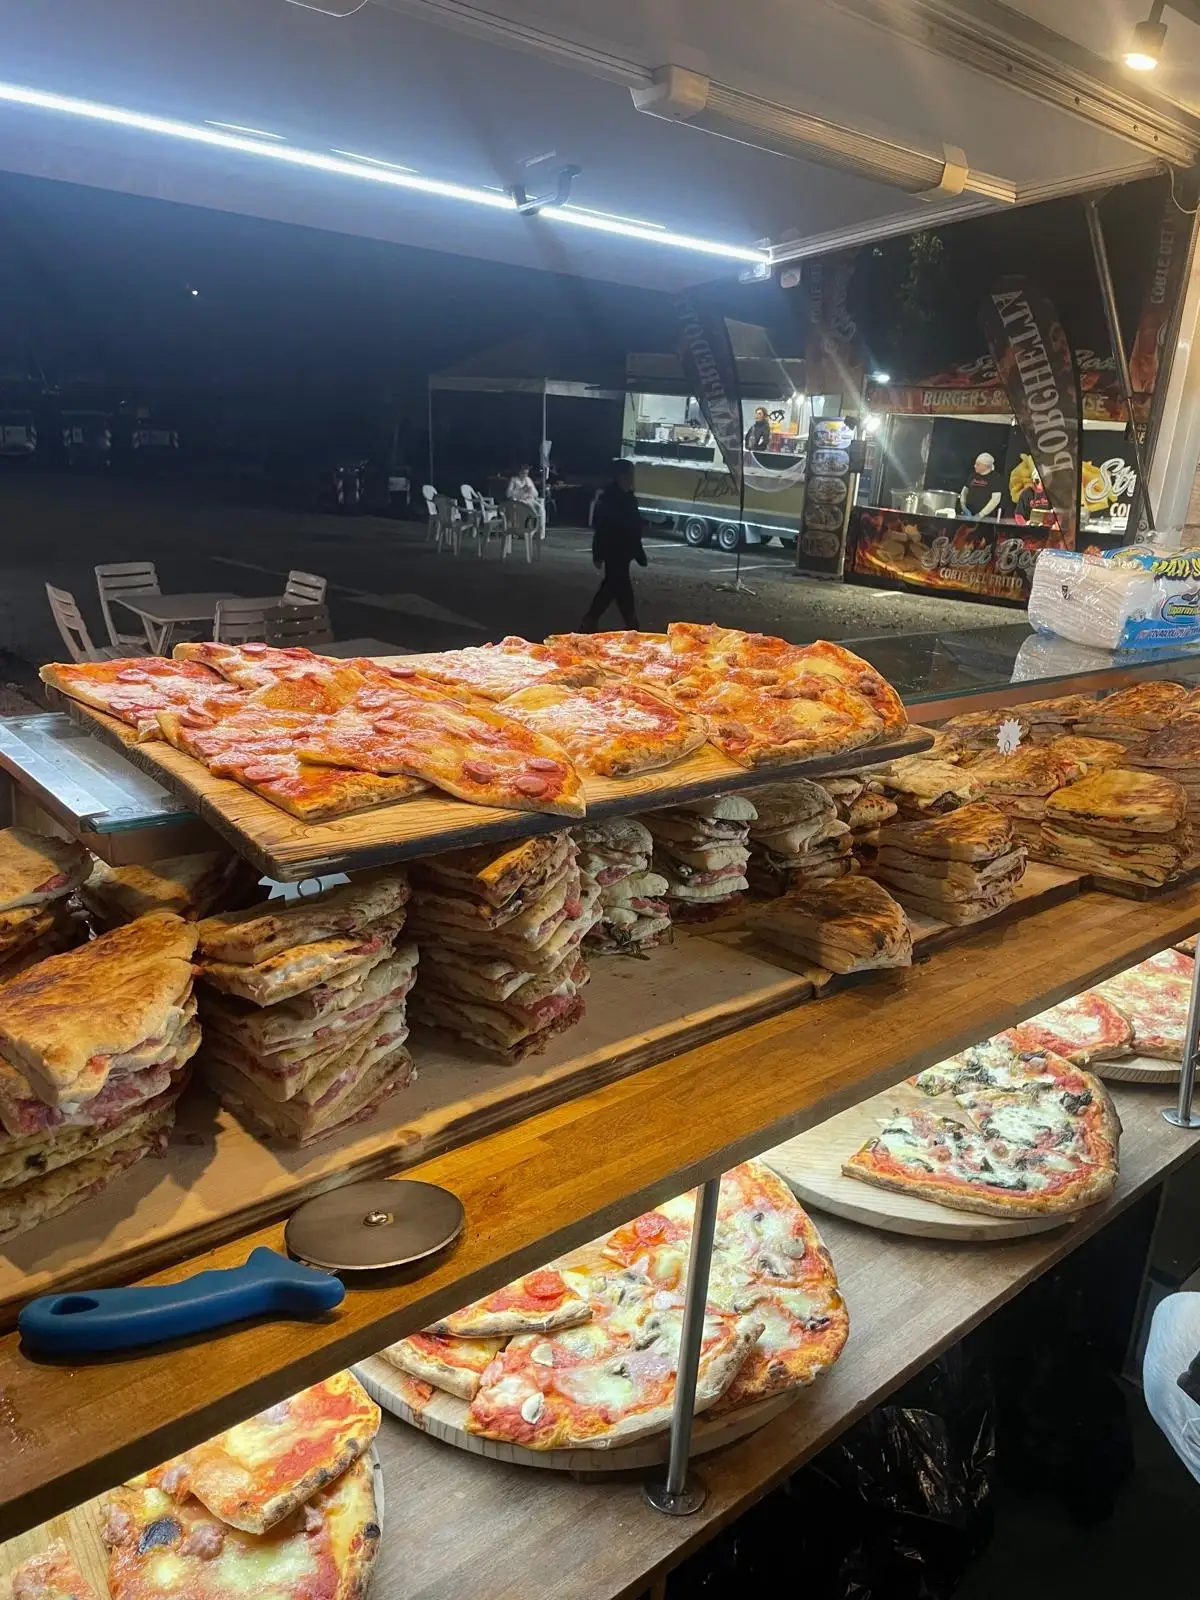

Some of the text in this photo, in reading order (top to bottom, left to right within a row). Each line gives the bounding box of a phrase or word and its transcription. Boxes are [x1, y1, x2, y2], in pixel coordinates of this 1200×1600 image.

[991, 289, 1074, 477] PORCHETTA
[922, 390, 989, 407] BURGERS
[921, 536, 993, 569] Street
[940, 567, 968, 581] CORTE
